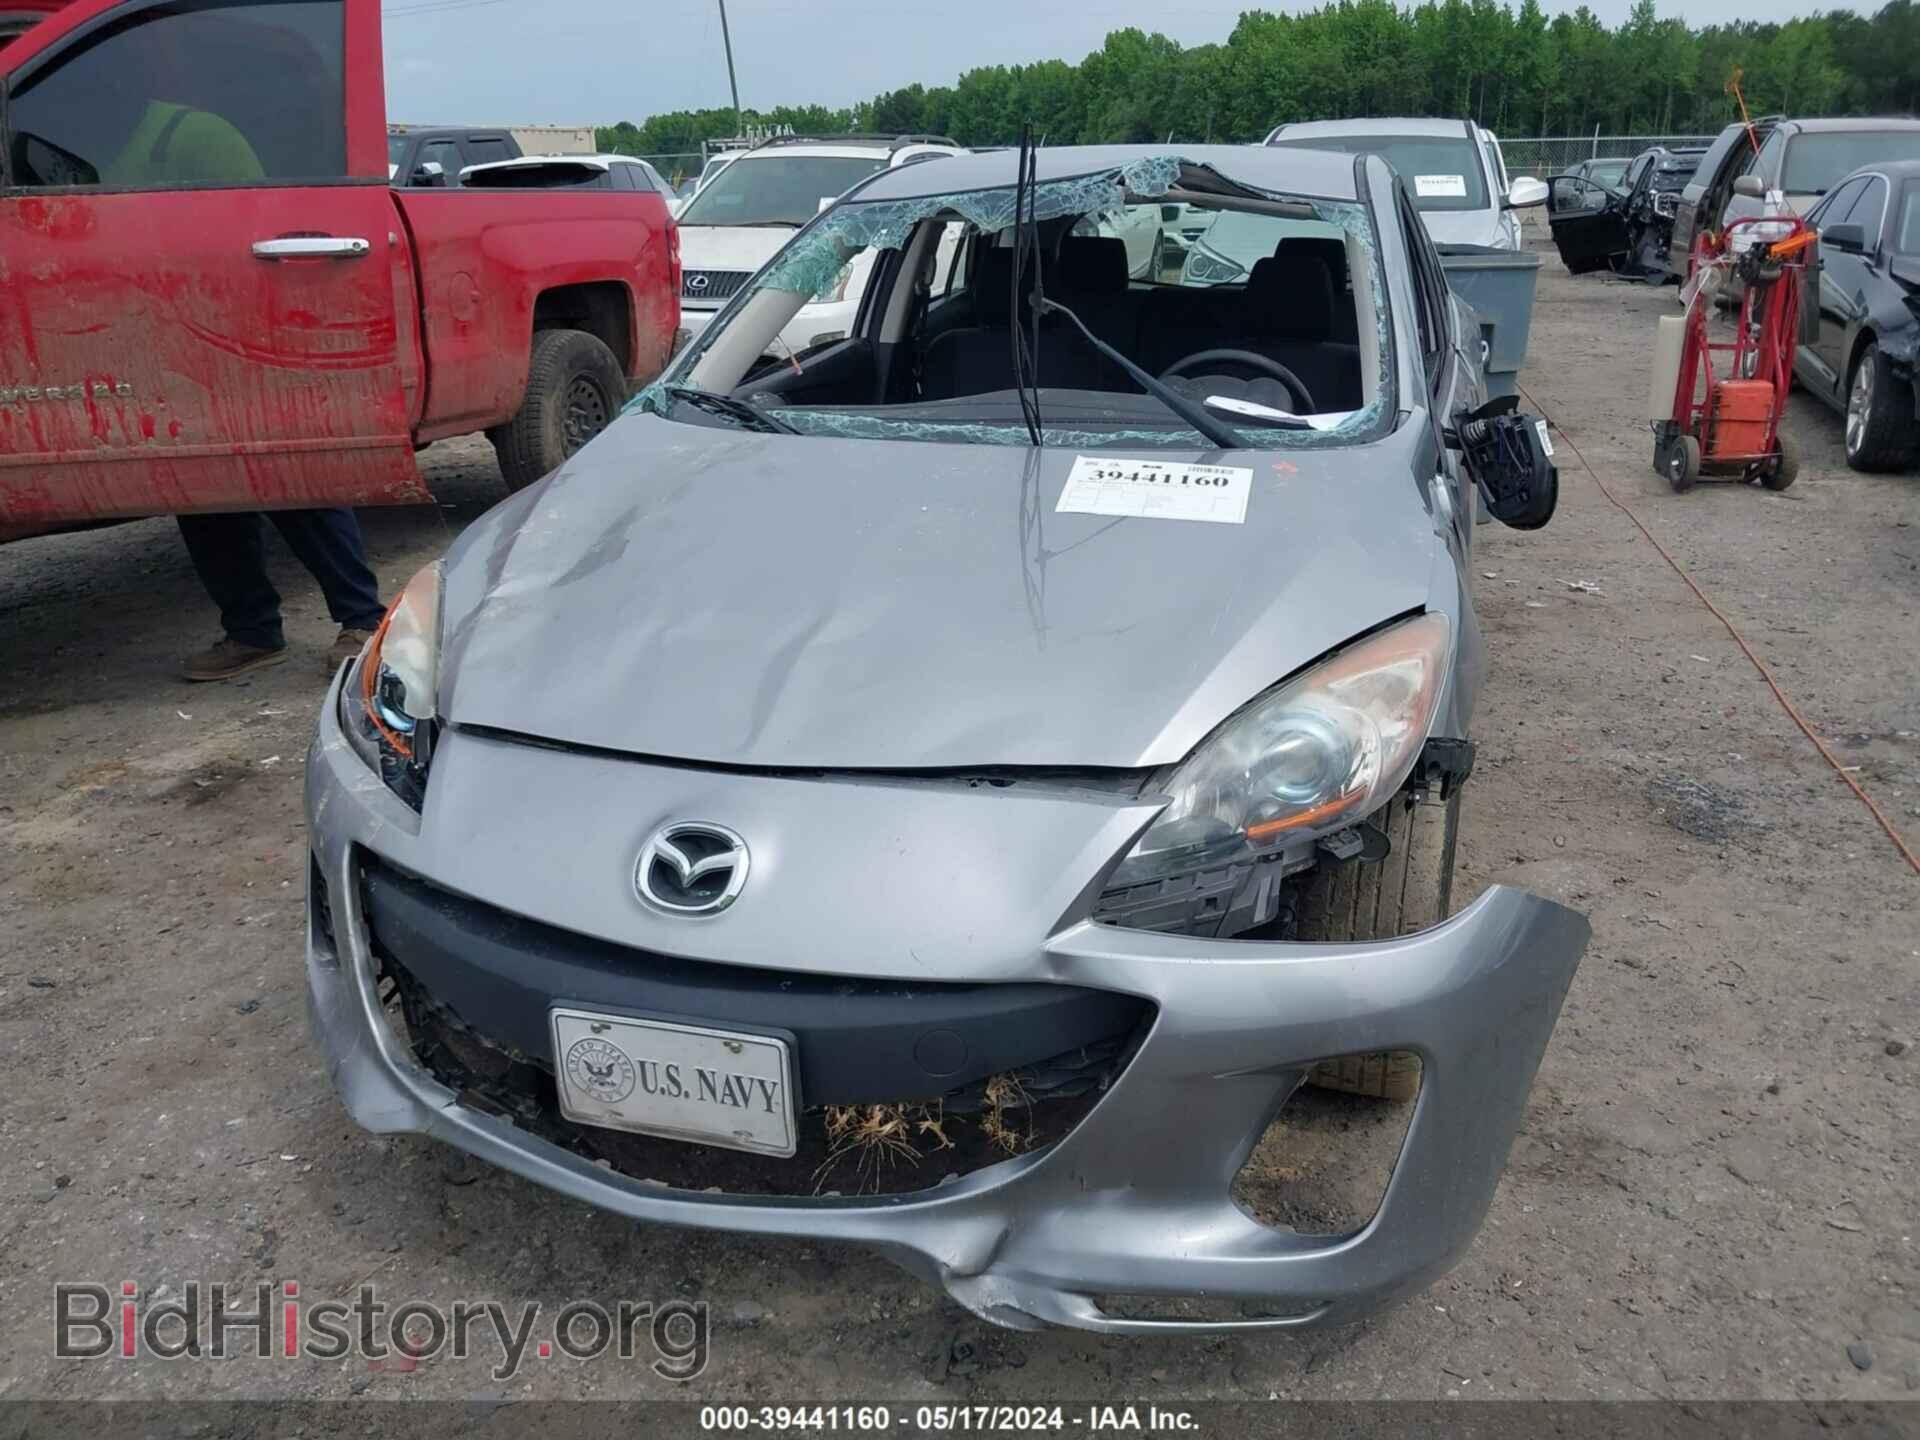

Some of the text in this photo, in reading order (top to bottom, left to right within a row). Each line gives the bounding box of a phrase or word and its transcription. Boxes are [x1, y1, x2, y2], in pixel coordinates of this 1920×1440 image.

[1088, 470, 1230, 488] 39441160
[638, 1059, 779, 1113] U.S. NAVY
